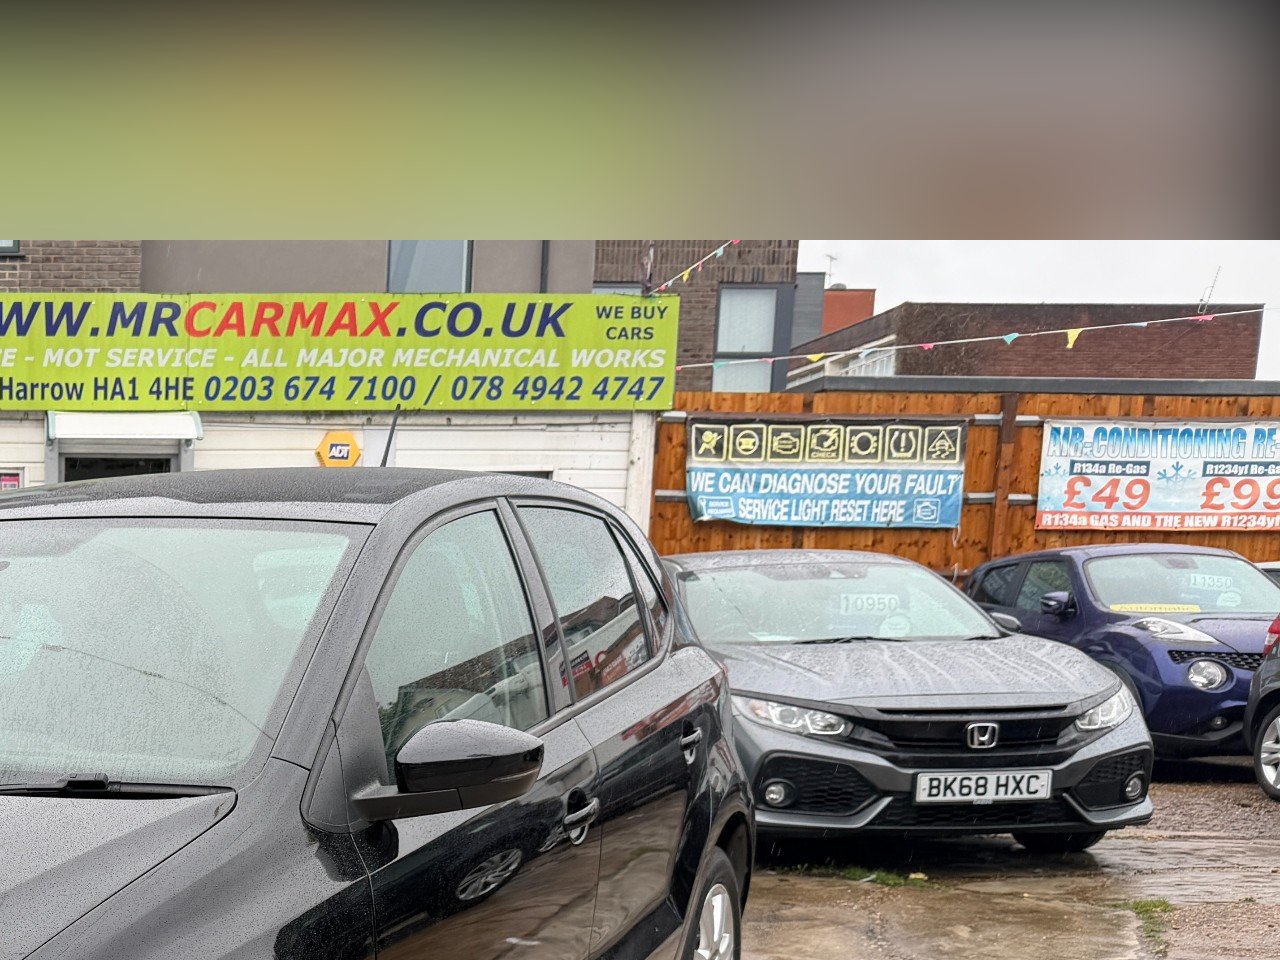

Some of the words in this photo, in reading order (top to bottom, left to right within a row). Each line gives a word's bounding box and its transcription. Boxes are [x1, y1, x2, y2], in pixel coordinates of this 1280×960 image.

[595, 305, 624, 320] WE
[630, 306, 669, 320] BUY
[605, 326, 654, 341] CARS
[42, 347, 100, 368] MOT
[104, 347, 216, 368] SERVICE
[240, 348, 288, 368] ALL
[295, 348, 386, 368] MAJOR
[391, 348, 561, 368] MECHANICAL
[569, 348, 666, 368] WORKS
[92, 376, 140, 401] HA1
[148, 376, 195, 401] 4HE
[204, 375, 274, 401] 0203
[283, 375, 336, 401] 674
[345, 375, 417, 401] 7100
[450, 375, 503, 401] 078
[511, 375, 582, 401] 4942
[590, 375, 665, 401] 4747
[328, 445, 350, 459] ADT
[1073, 462, 1107, 474] R134a
[1107, 463, 1148, 475] Re-Gas
[1205, 463, 1250, 476] R1234yf
[690, 471, 716, 493] WE
[718, 471, 756, 494] CAN
[759, 472, 851, 494] DIAGNOSE
[855, 472, 902, 495] YOUR
[904, 473, 961, 496] FAULT
[1062, 475, 1151, 511] £49
[1200, 476, 1280, 511] £99
[738, 497, 790, 521] SERVICE
[790, 499, 830, 522] LIGHT
[830, 499, 871, 523] RESET
[871, 500, 906, 523] HERE
[1041, 513, 1087, 527] R134a
[1089, 514, 1120, 527] GAS
[1121, 515, 1152, 528] AND
[1155, 515, 1181, 528] THE
[1184, 515, 1219, 528] NEW
[843, 594, 898, 614] 10950
[926, 776, 989, 798] BK68
[994, 774, 1040, 796] HXC
